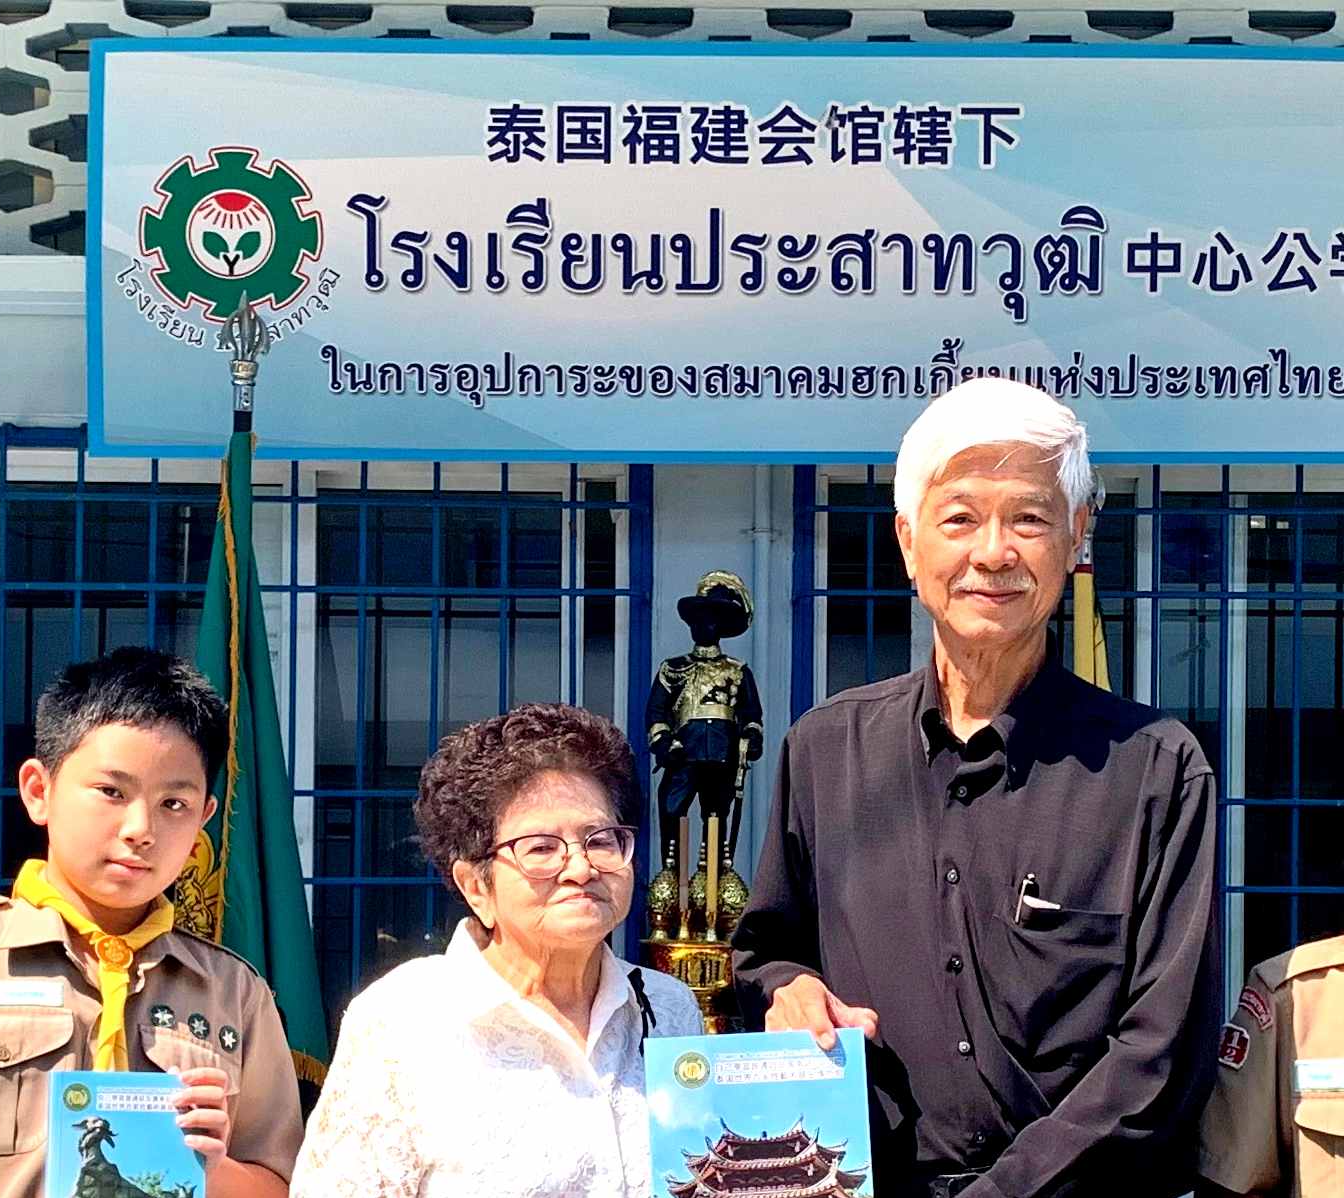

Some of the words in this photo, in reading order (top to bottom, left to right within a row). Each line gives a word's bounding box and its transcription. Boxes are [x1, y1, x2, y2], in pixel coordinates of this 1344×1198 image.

[486, 103, 1022, 166] 泰国福建会馆辖下
[346, 194, 1105, 322] โรงเรียนประสาทวุฒิ
[116, 257, 205, 347] โรงเรียน
[1223, 1047, 1237, 1062] 2
[1227, 1031, 1242, 1049] 1
